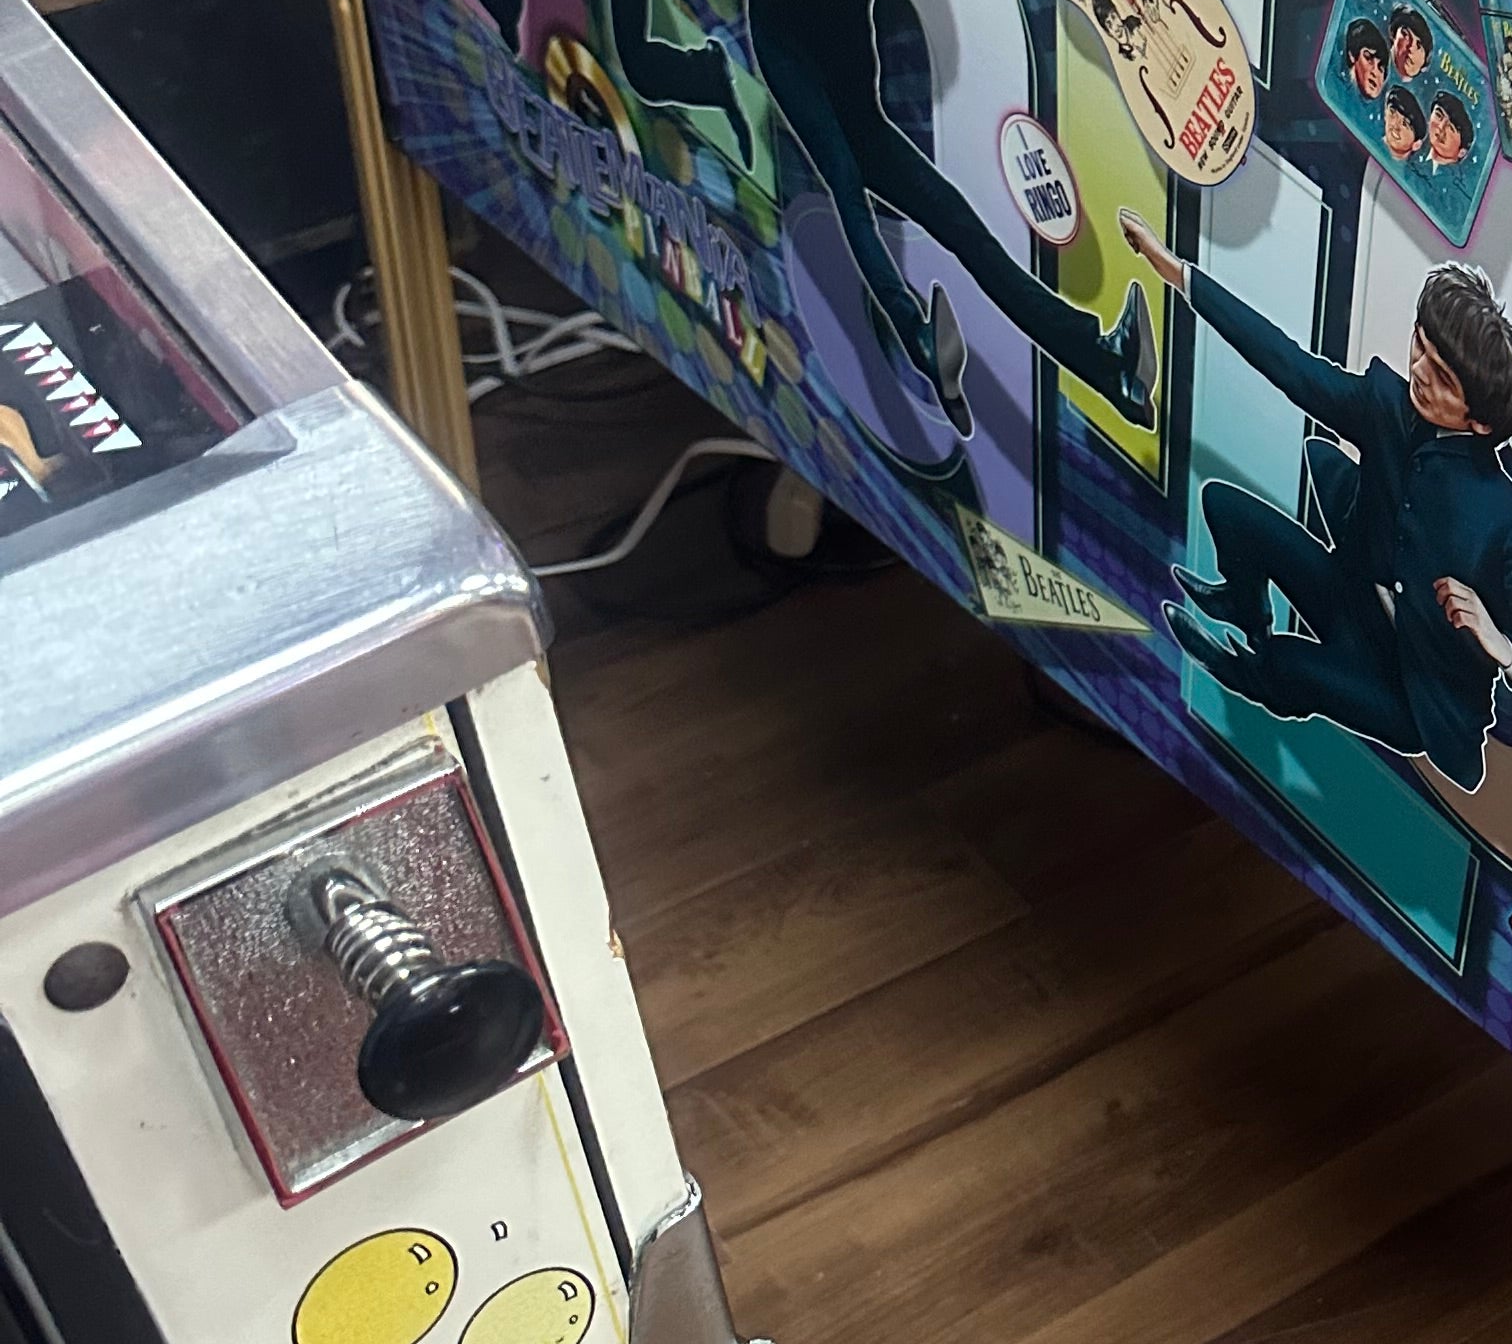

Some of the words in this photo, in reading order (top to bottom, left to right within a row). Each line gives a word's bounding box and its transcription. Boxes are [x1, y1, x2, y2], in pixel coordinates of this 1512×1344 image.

[1440, 51, 1479, 106] BEATLES
[1178, 56, 1236, 161] BEATLES
[1224, 85, 1244, 120] GUITAR
[1016, 123, 1029, 151] I
[1016, 148, 1052, 181] LOVE
[1024, 179, 1072, 223] RINGO
[1017, 553, 1101, 623] BEATLES
